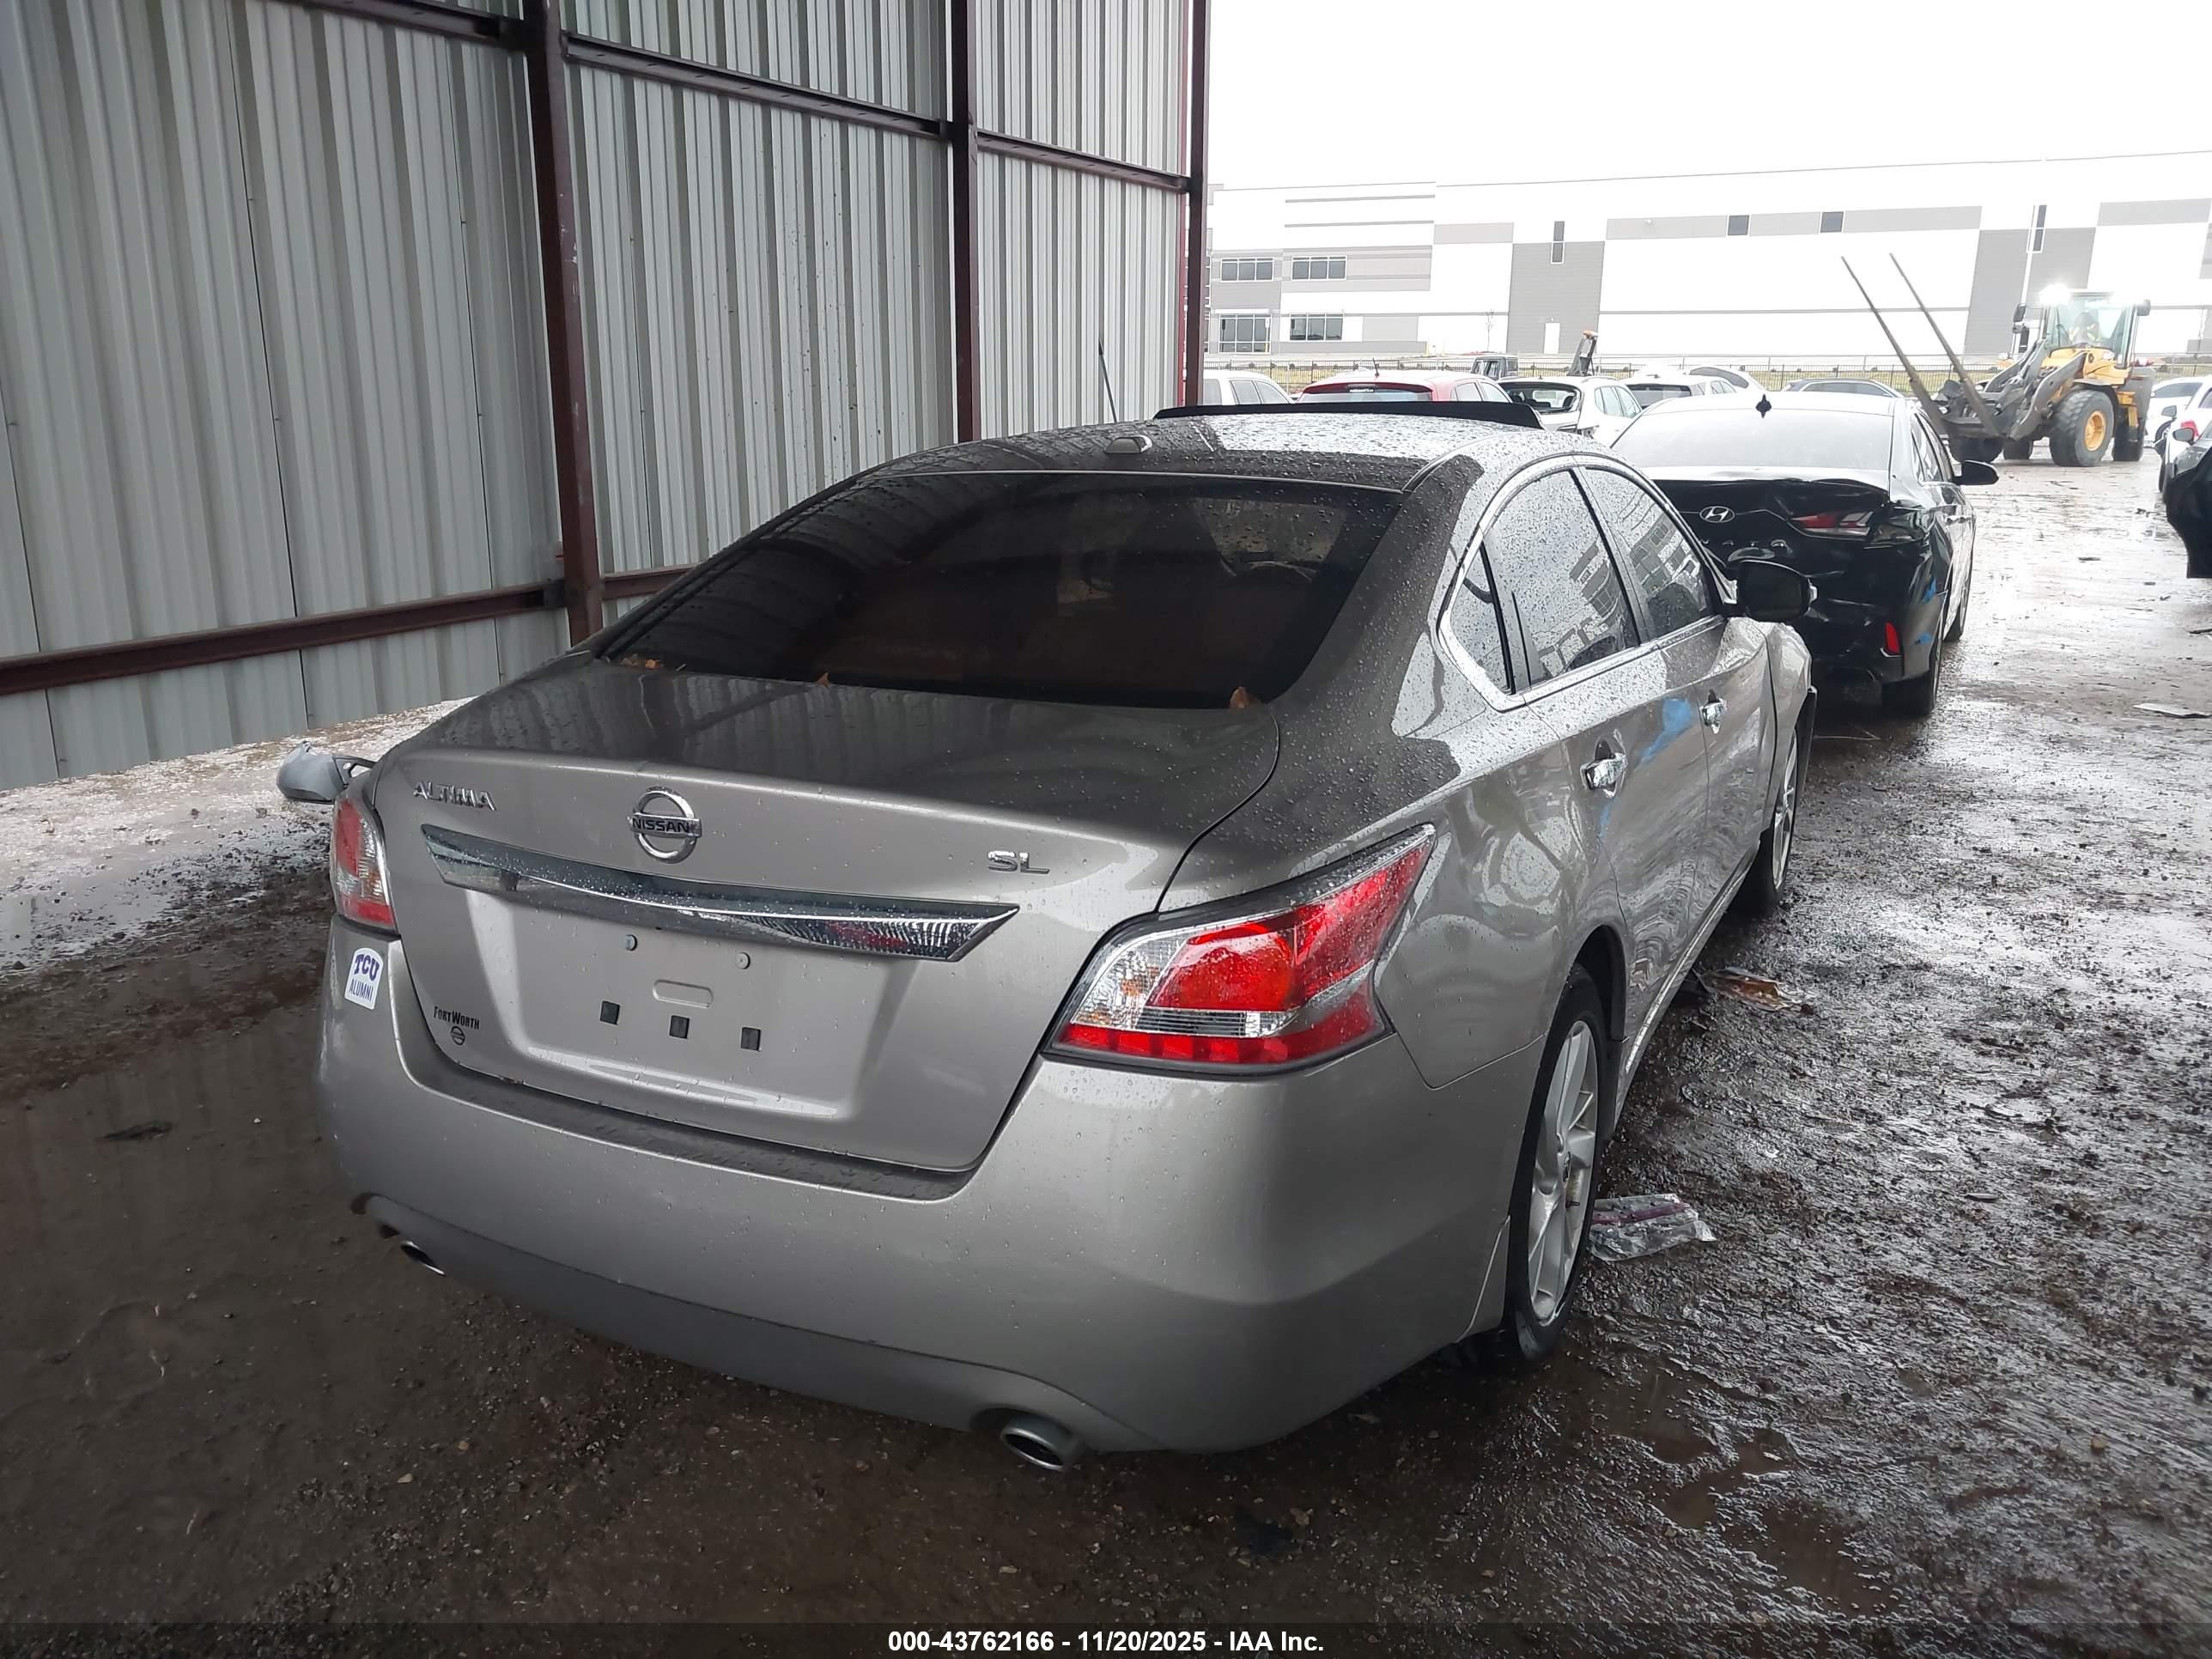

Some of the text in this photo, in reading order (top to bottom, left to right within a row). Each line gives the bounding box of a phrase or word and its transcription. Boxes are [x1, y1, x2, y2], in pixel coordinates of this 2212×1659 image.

[413, 781, 496, 811] ALTIMA
[632, 817, 690, 833] NISSAN
[988, 850, 1050, 875] SL
[354, 954, 380, 981] TCU
[349, 978, 374, 1002] ALUMNI
